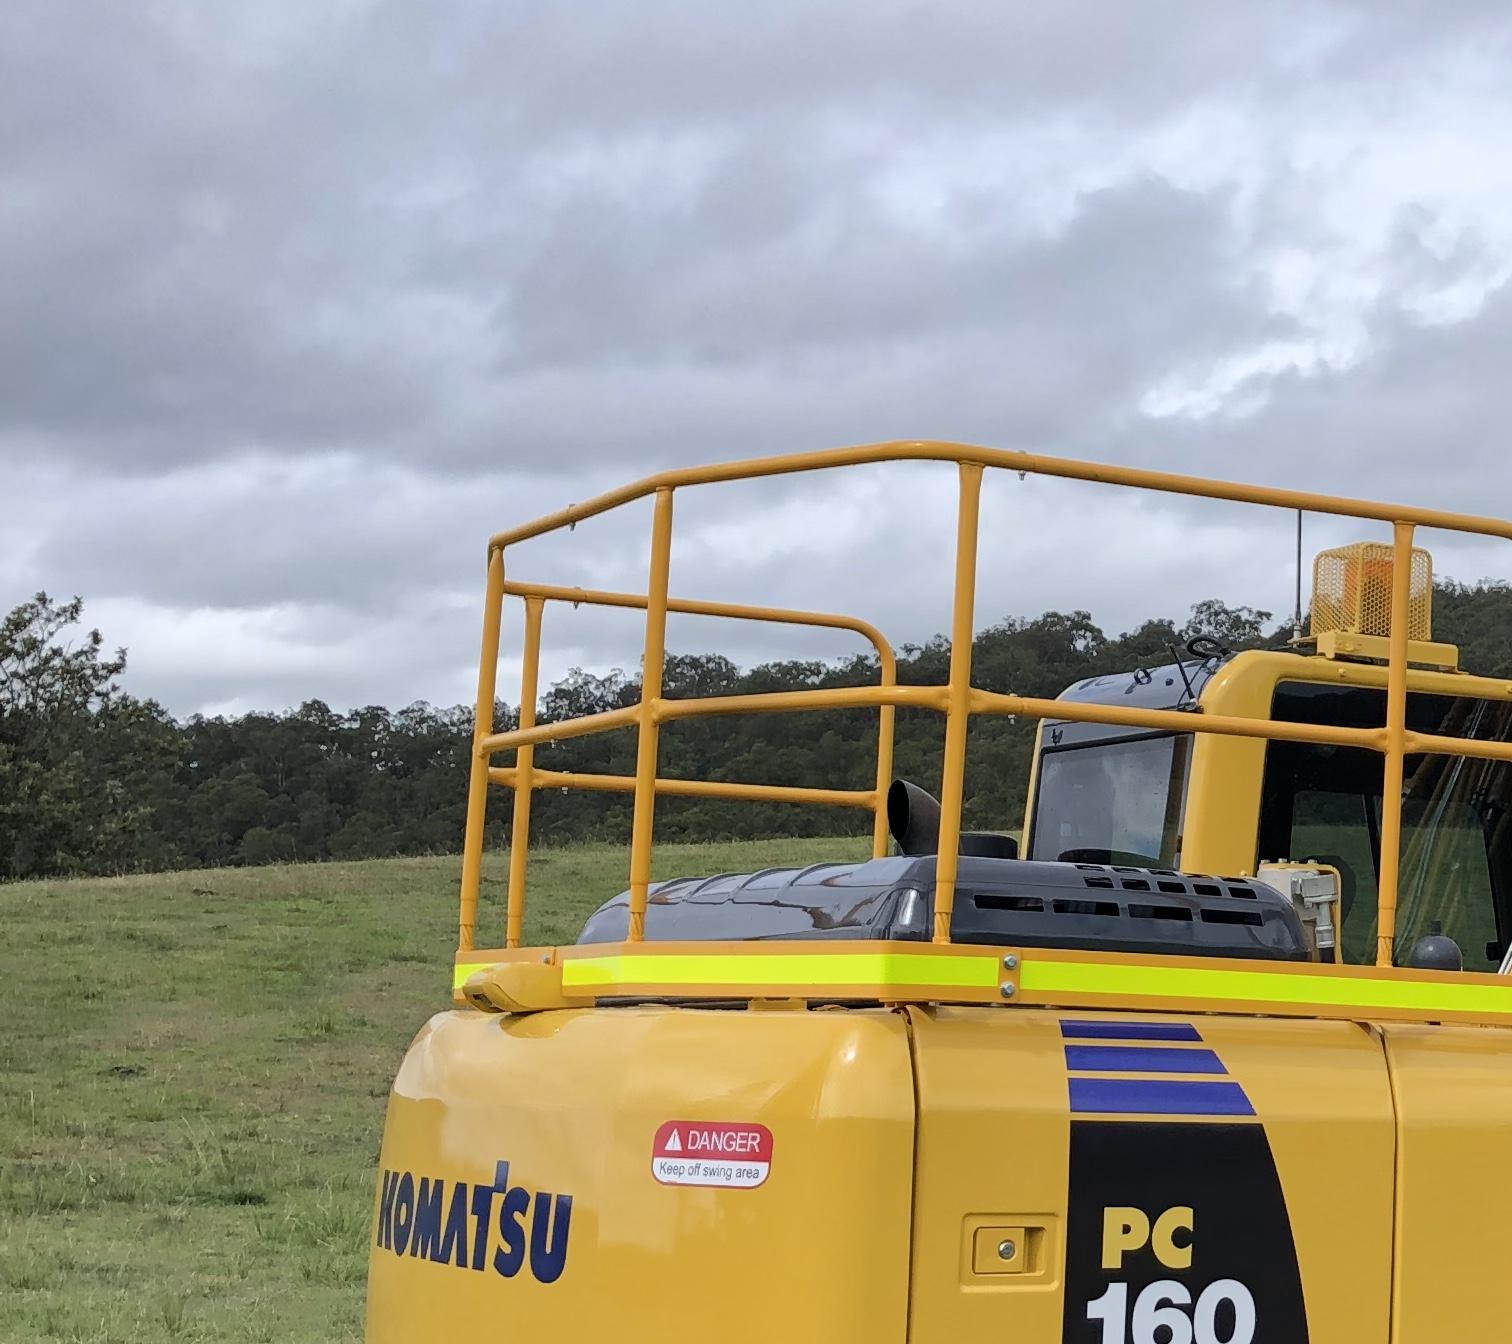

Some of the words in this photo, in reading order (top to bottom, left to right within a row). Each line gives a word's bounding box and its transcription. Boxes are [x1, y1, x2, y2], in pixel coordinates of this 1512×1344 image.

[687, 1130, 760, 1152] DANGER
[659, 1162, 685, 1178] Keep
[687, 1163, 701, 1176] off
[703, 1165, 732, 1181] swing
[735, 1167, 759, 1179] area
[377, 1160, 573, 1283] KOMATSU
[1102, 1206, 1194, 1269] PC
